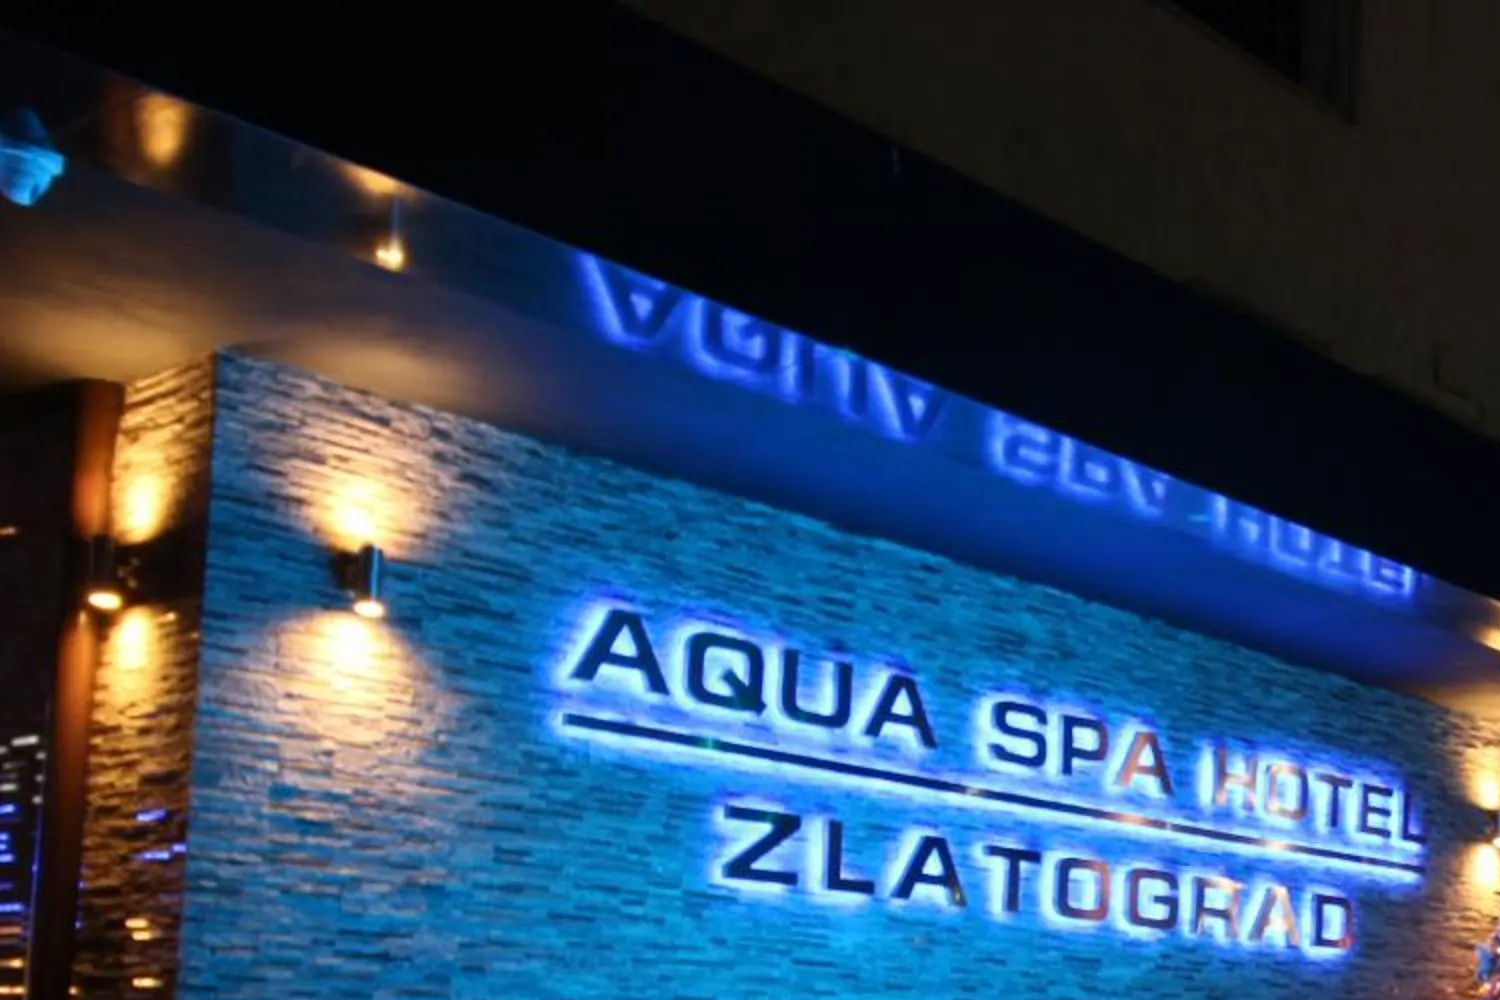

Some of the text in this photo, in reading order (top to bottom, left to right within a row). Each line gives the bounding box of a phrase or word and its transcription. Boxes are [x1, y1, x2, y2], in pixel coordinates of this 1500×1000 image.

[568, 609, 1428, 846] AQUA SPA HOTEL
[722, 804, 1355, 950] ZLATOGRAD
